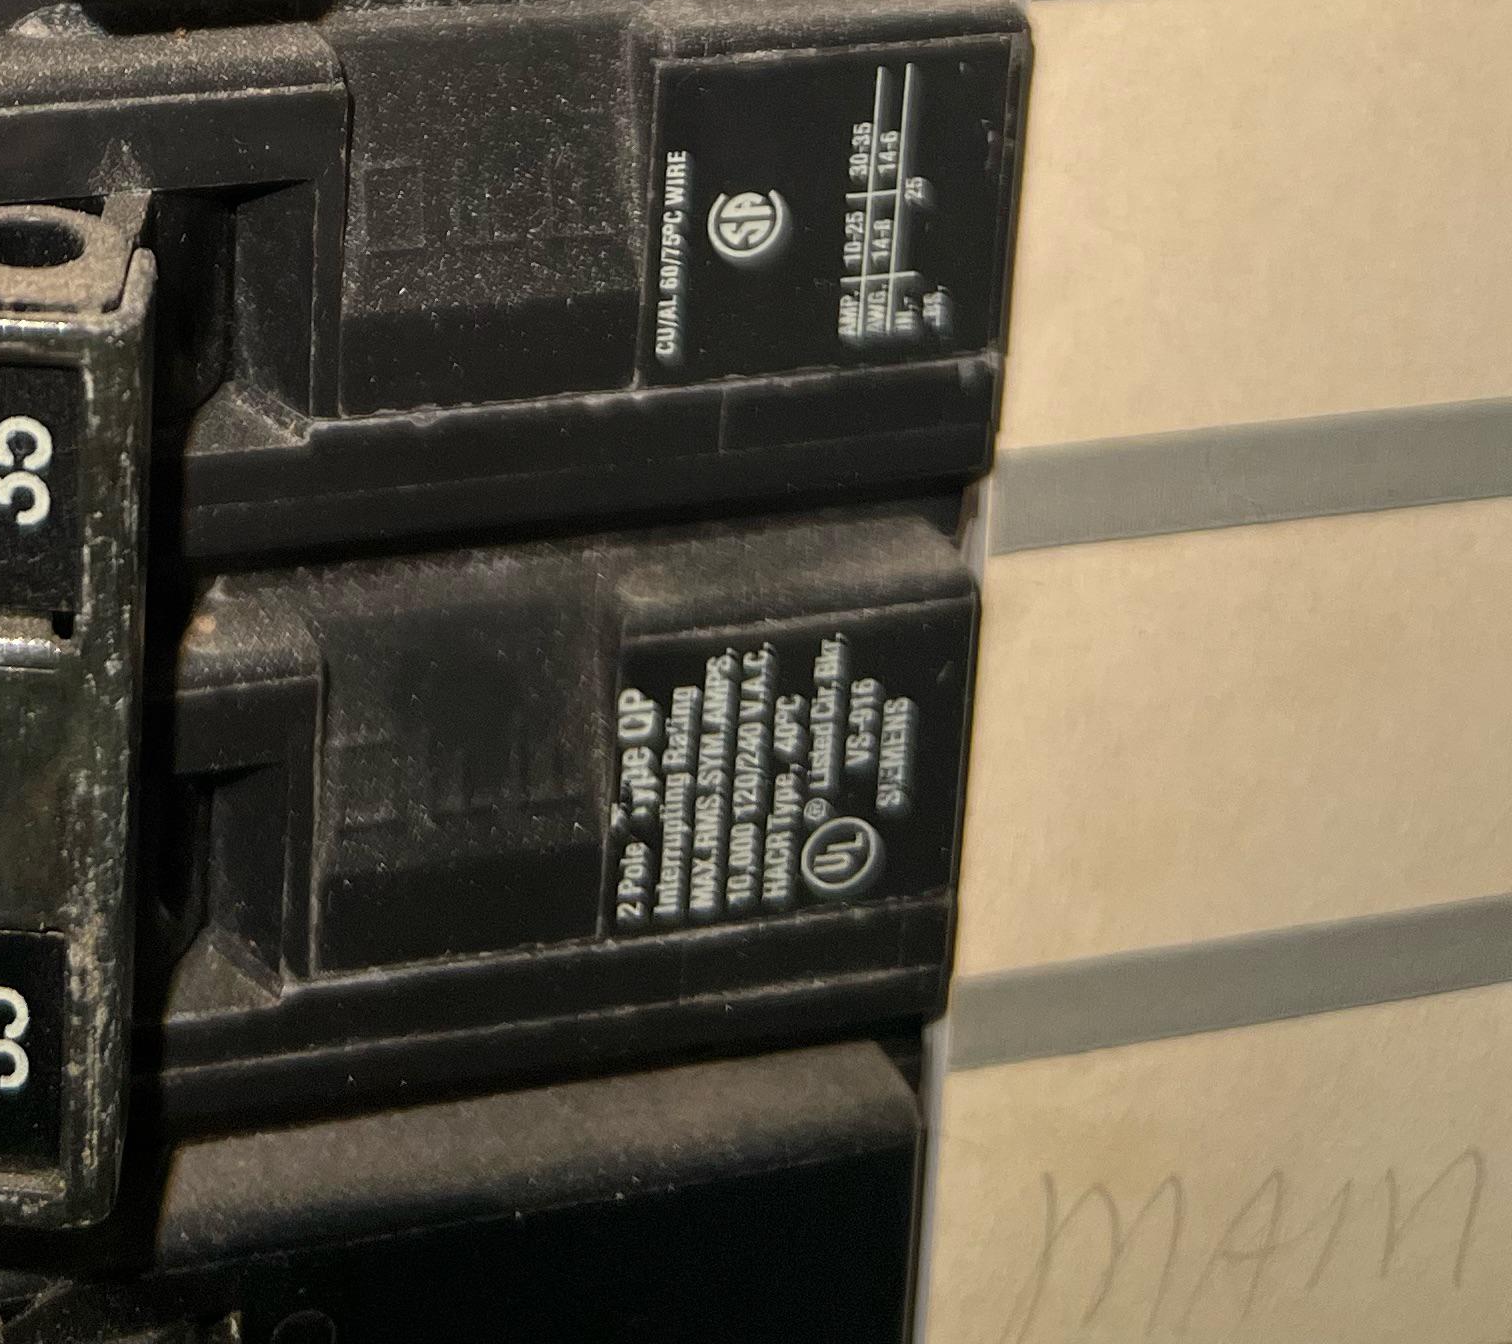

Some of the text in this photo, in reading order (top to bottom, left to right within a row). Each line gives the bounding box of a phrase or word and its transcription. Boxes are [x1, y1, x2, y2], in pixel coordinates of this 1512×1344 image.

[664, 150, 688, 208] WIRE
[655, 294, 681, 356] CU/AL
[734, 721, 770, 819] 120/240
[808, 721, 838, 791] Listed
[875, 695, 913, 810] SIEMENS
[653, 685, 700, 917] Interrupting Rating
[618, 841, 650, 899] Pole
[762, 829, 793, 902] HACR
